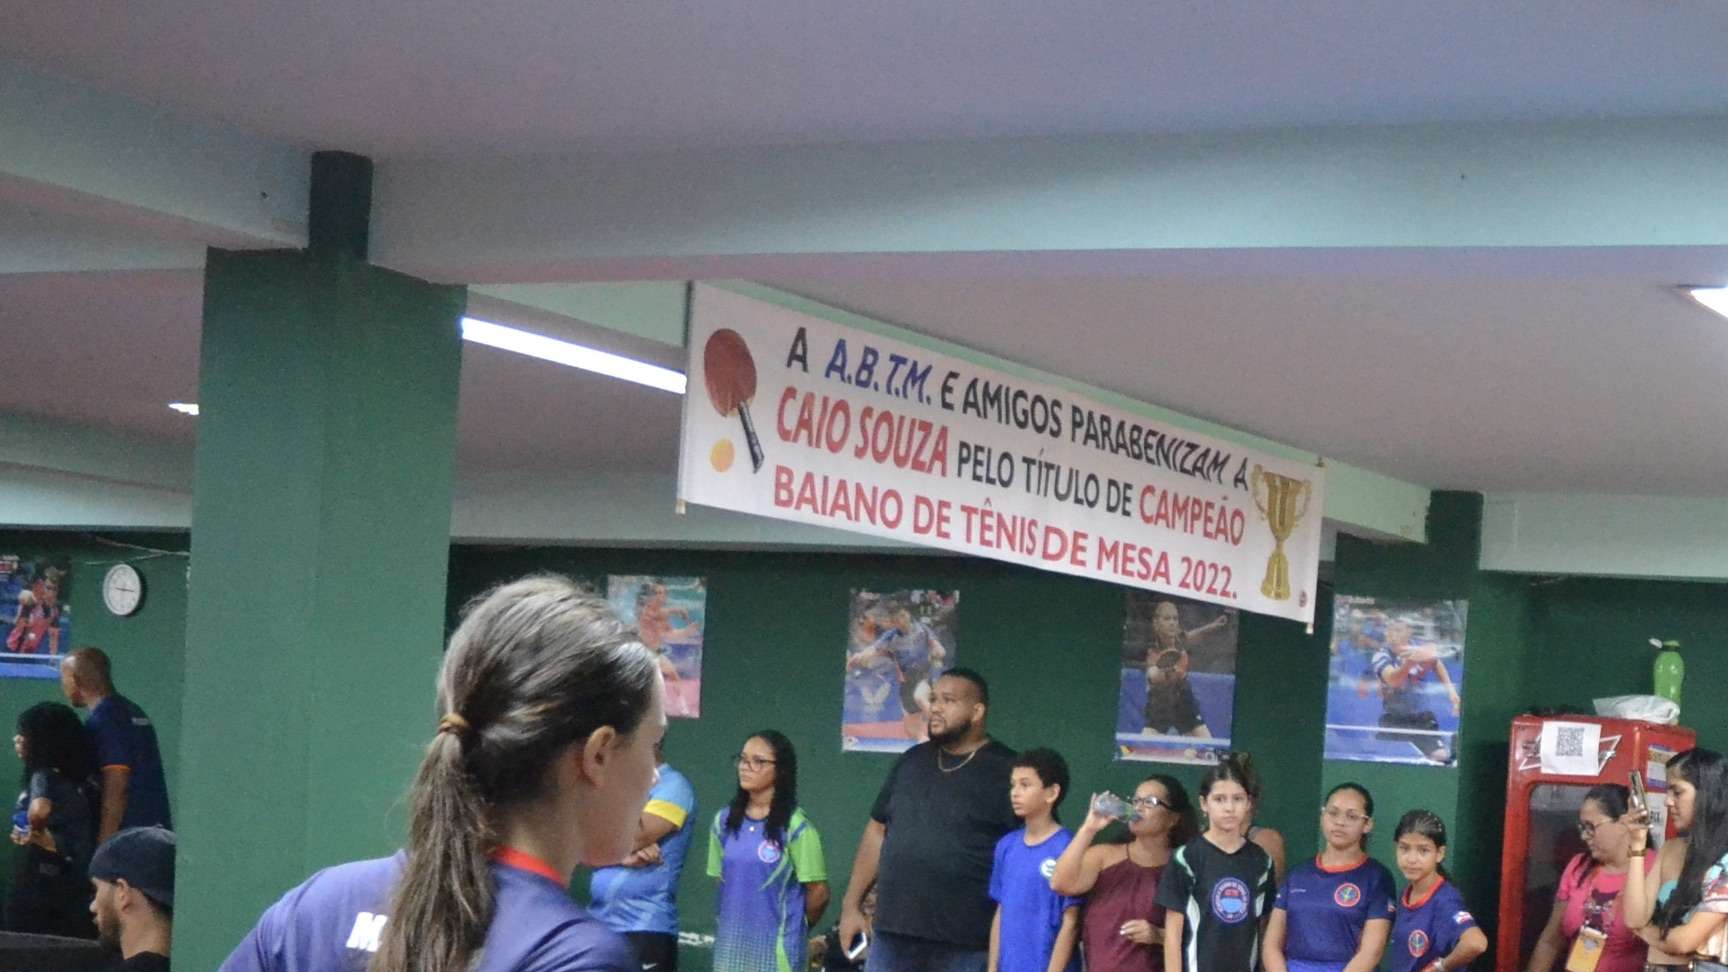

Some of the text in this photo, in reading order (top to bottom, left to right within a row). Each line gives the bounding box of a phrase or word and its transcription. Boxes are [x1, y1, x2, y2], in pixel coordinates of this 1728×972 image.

[777, 386, 1245, 546] CAIO SOUZA PELO TÍTULO DE CAMPEÃO
[786, 327, 1249, 491] A A.B.T.M. E AMIGOS PARABENIZAM A
[774, 464, 1238, 599] BAIANO DE TÊNIS DE MESA 2022.
